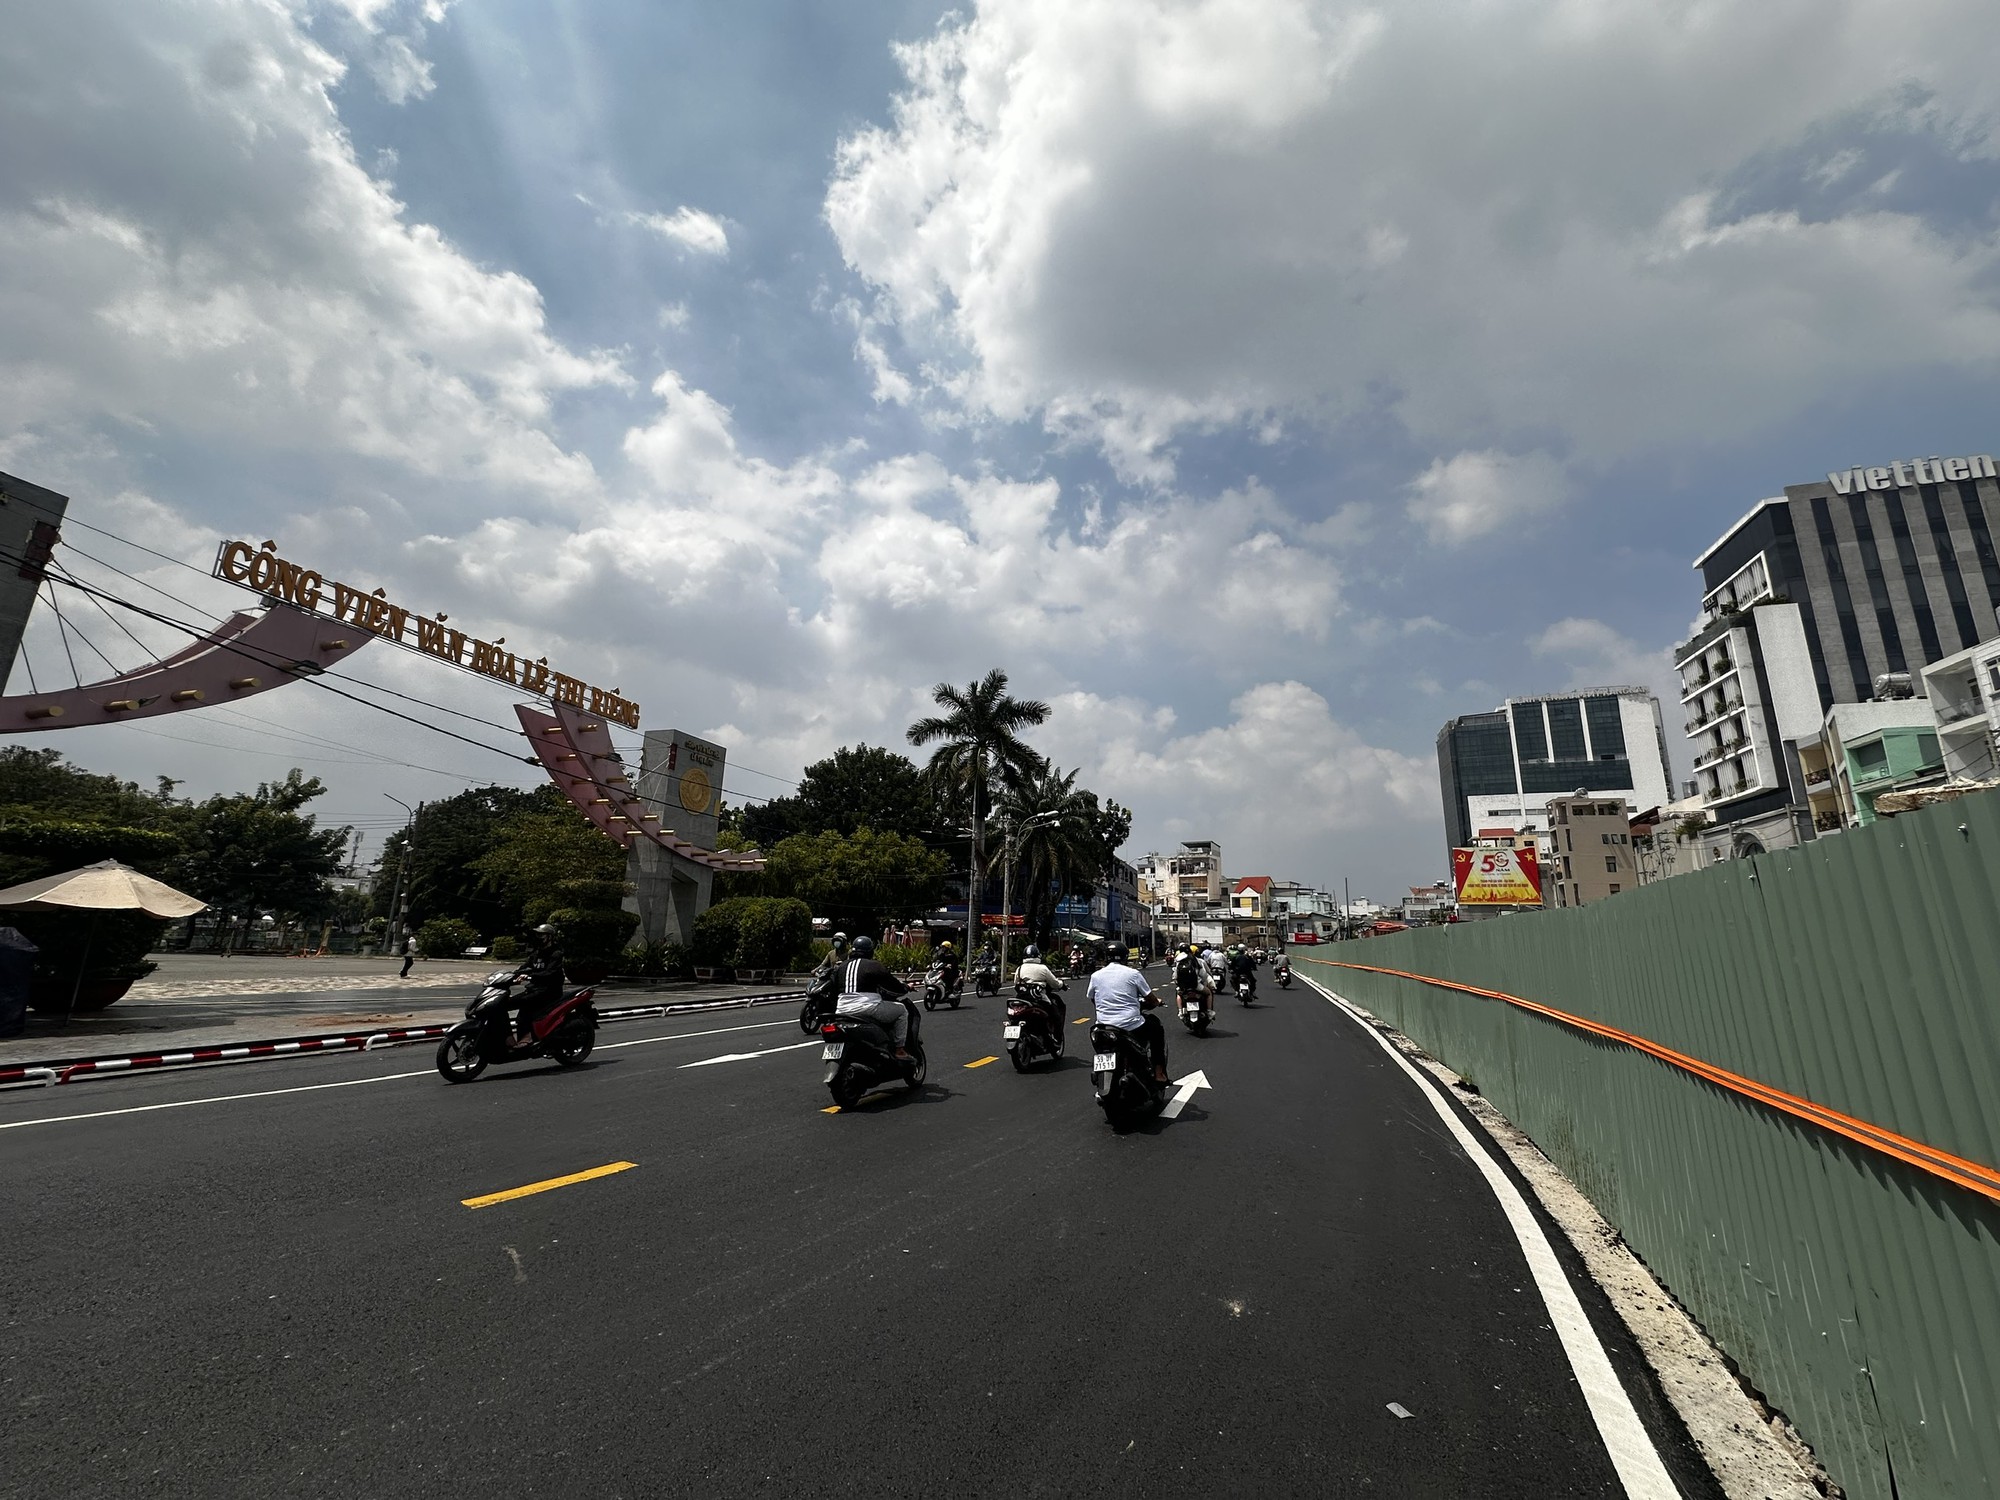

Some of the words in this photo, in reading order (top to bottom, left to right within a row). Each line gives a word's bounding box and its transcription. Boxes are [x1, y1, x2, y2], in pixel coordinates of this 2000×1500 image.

[222, 540, 322, 611] CÔNG
[334, 582, 410, 642] VIÊN
[417, 612, 467, 664] VĂN
[469, 637, 517, 684] HÓA
[521, 656, 549, 694] LÊ
[589, 687, 640, 730] RIÊNG
